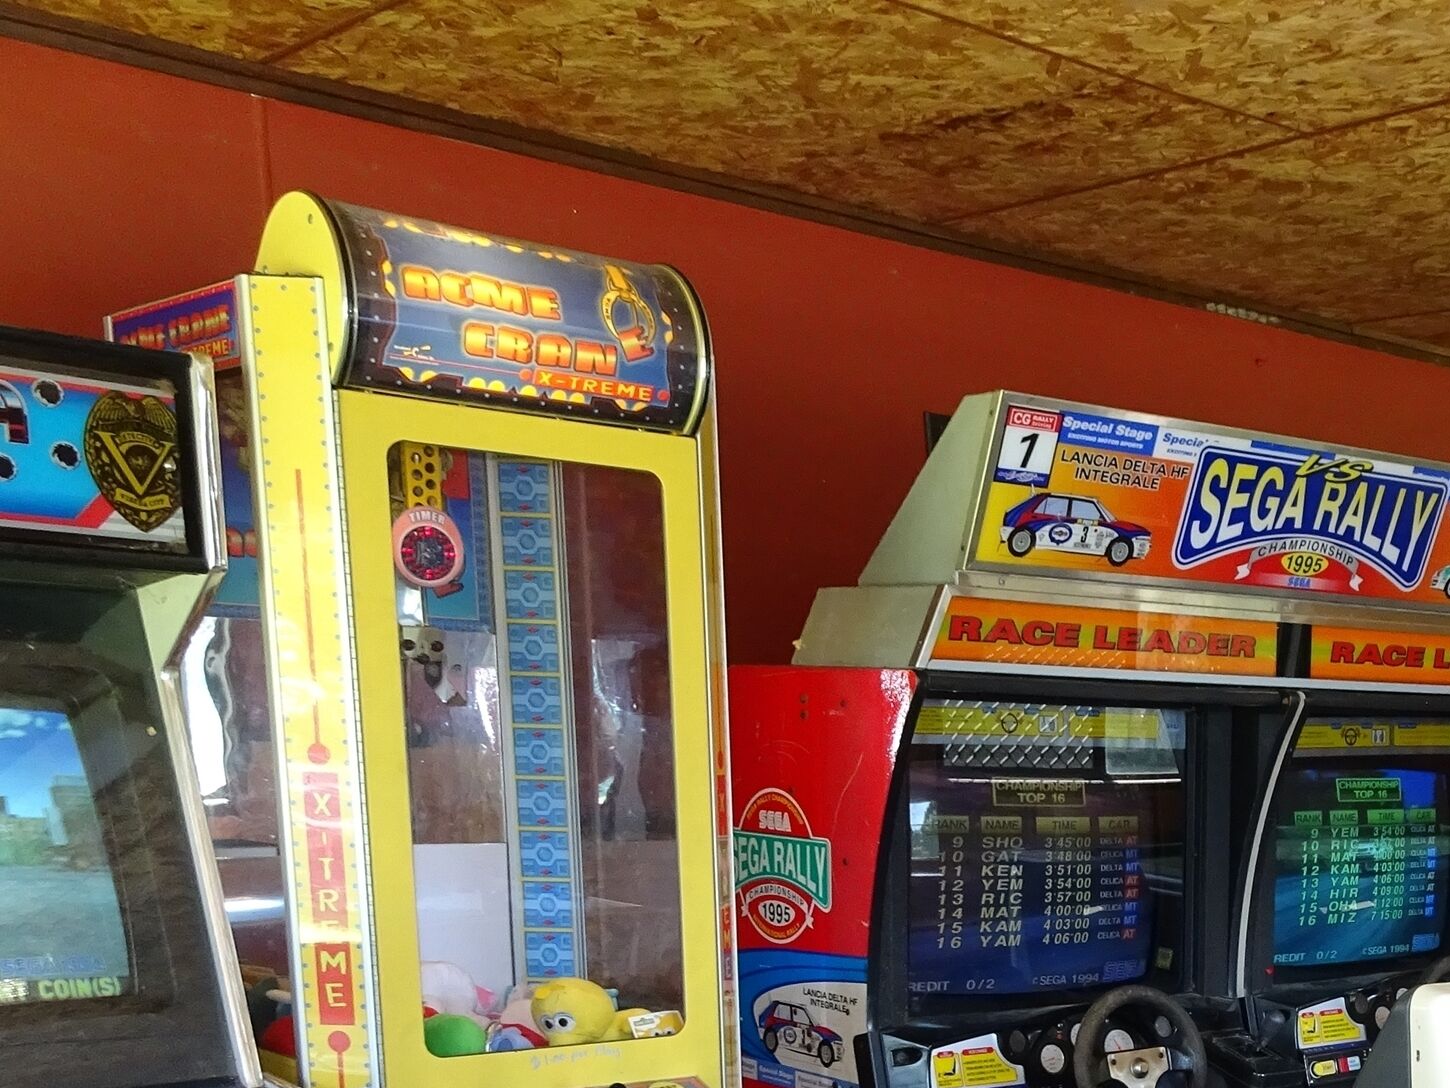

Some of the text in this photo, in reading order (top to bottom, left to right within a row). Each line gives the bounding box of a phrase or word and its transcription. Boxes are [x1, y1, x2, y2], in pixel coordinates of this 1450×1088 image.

[402, 266, 562, 320] ACME
[537, 372, 653, 402] X-TREME
[1013, 411, 1031, 425] CG
[1063, 416, 1153, 442] Special Stage
[1163, 432, 1206, 448] Specia
[1020, 432, 1040, 469] 1
[1061, 450, 1189, 478] LANCIA DELTA HF
[1074, 467, 1160, 490] INTEGRALE
[408, 510, 447, 525] TIMER
[1191, 457, 1438, 573] SEGA RALLY
[1257, 539, 1354, 566] CHAMPIONSHIP
[1287, 555, 1322, 574] 1995
[948, 615, 1257, 658] RACE LEADER
[1330, 641, 1426, 668] RACE
[996, 780, 1082, 792] CHAMPIONSHIP
[1339, 780, 1399, 790] CHAMPIONSHIP
[1017, 792, 1066, 804] TOP 16
[1353, 790, 1388, 799] TOP 16
[758, 809, 792, 833] SEGA
[985, 819, 1021, 831] NAME
[1052, 820, 1078, 831] TIME
[1330, 827, 1359, 838] YEM
[952, 836, 964, 849] 9
[981, 836, 1023, 849] SHO
[1301, 840, 1319, 852] 10
[981, 850, 1023, 862] GAT
[1301, 853, 1319, 864] 11
[774, 841, 826, 899] RALLY
[981, 864, 1024, 877] KEN
[1301, 863, 1360, 876] 12 KAM
[938, 879, 964, 892] 12
[981, 878, 1024, 891] YEM
[1300, 876, 1360, 889] 13 YAM
[749, 885, 805, 905] CHAMPIONSHIP
[938, 892, 964, 905] 13
[981, 892, 1023, 905] RIC
[1300, 890, 1318, 901] 14
[1329, 887, 1359, 899] HIR
[762, 902, 791, 924] 1995
[938, 907, 963, 920] 14
[980, 906, 1022, 919] MAT
[1300, 902, 1318, 914] 15
[937, 922, 963, 934] 15
[979, 920, 1022, 933] KAM
[1299, 912, 1357, 927] 16 MIZ
[936, 936, 962, 949] 16
[979, 934, 1022, 948] YAM
[1273, 952, 1306, 964] REDIT
[908, 980, 951, 992] REDIT
[1072, 973, 1100, 986] 1994
[802, 987, 827, 1000] LANCIA
[828, 992, 848, 1004] DELTA
[810, 998, 846, 1013] INTEGRALE
